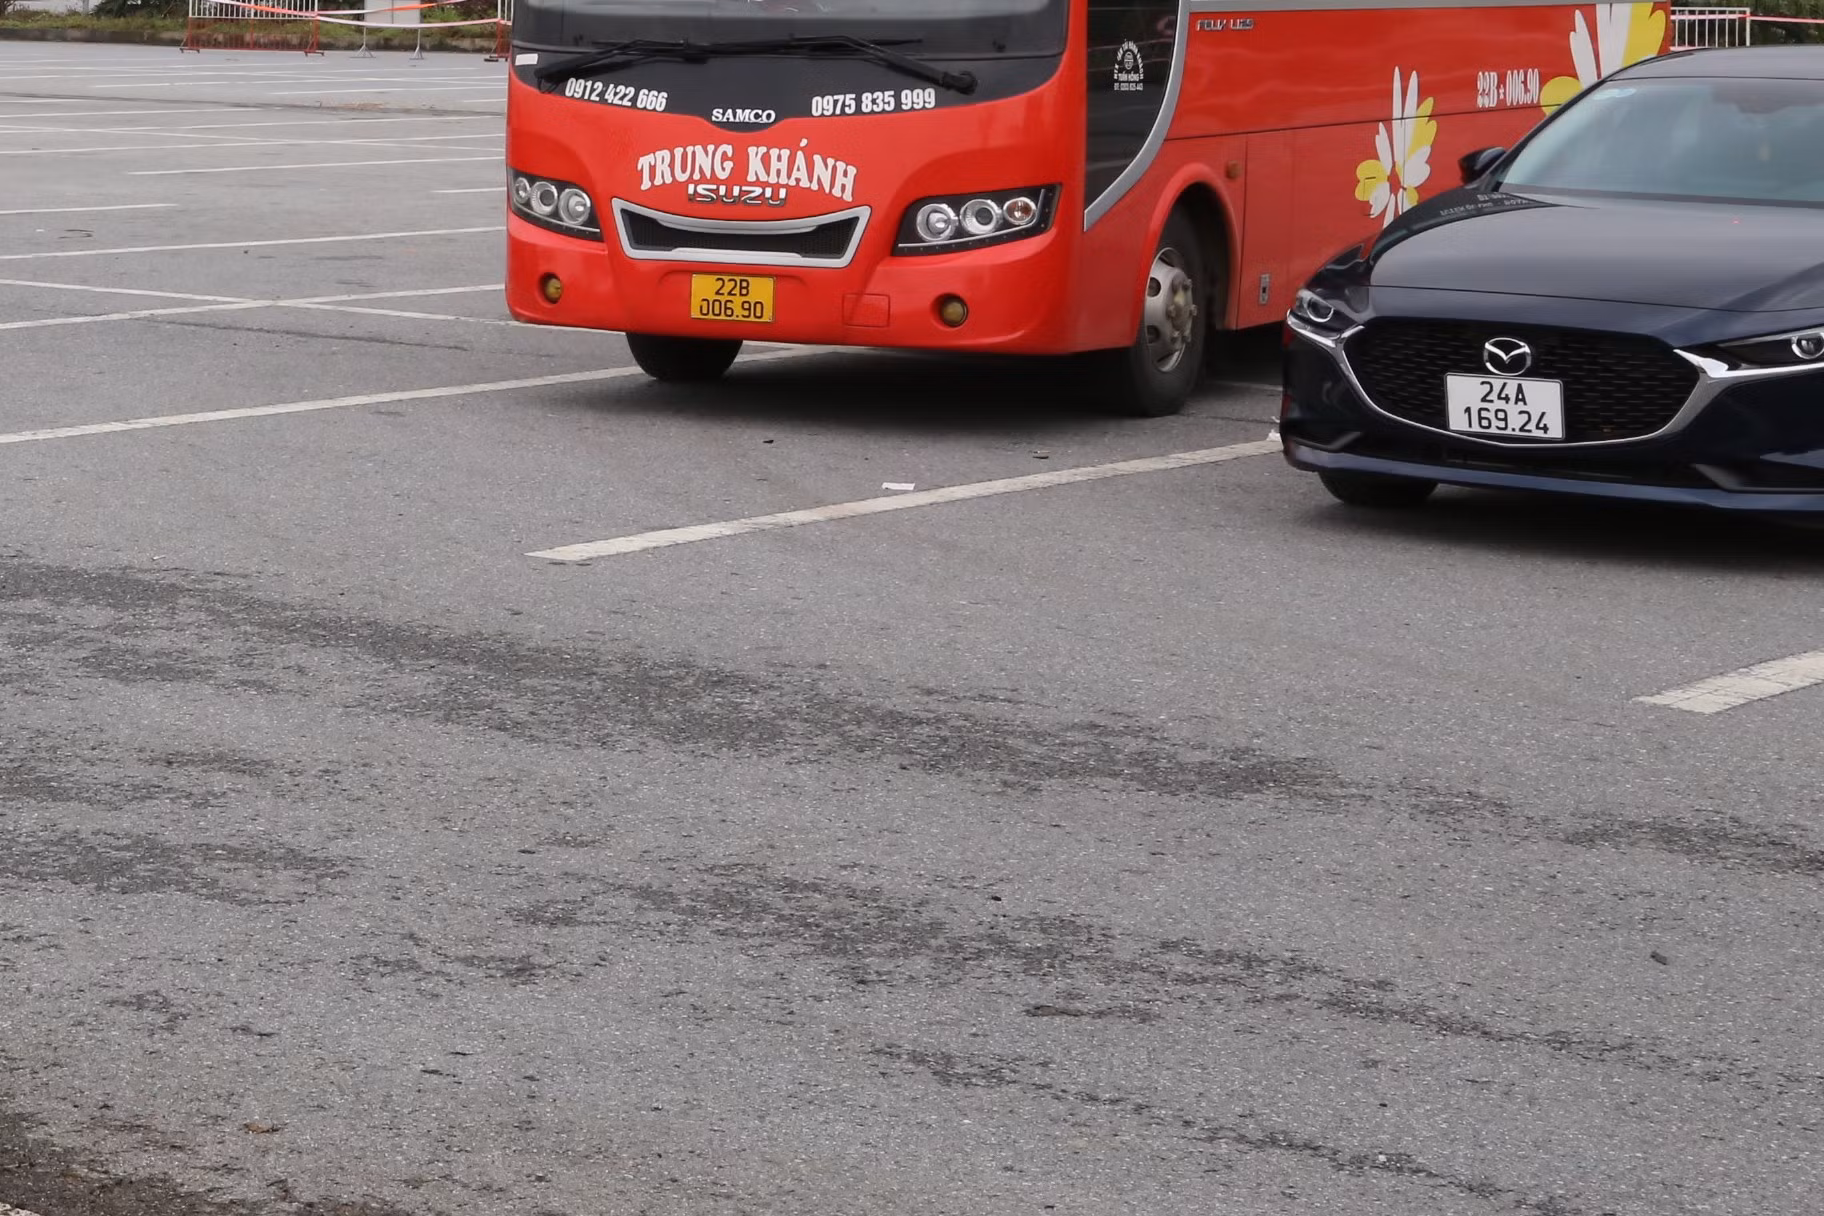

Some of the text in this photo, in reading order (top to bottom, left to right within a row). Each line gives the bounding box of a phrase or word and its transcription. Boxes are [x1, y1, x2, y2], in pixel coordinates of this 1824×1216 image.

[565, 77, 668, 112] 0912 422 666
[1477, 68, 1540, 108] 22B 006.90
[711, 108, 776, 124] SAMCO
[811, 88, 936, 117] 0975 835 999
[637, 138, 857, 202] TRUNG KHÁNH
[687, 183, 787, 206] ISUZU
[714, 277, 750, 297] 22B
[699, 298, 764, 319] 006.90
[1480, 380, 1528, 406] 24A
[1463, 406, 1549, 434] 169.24
